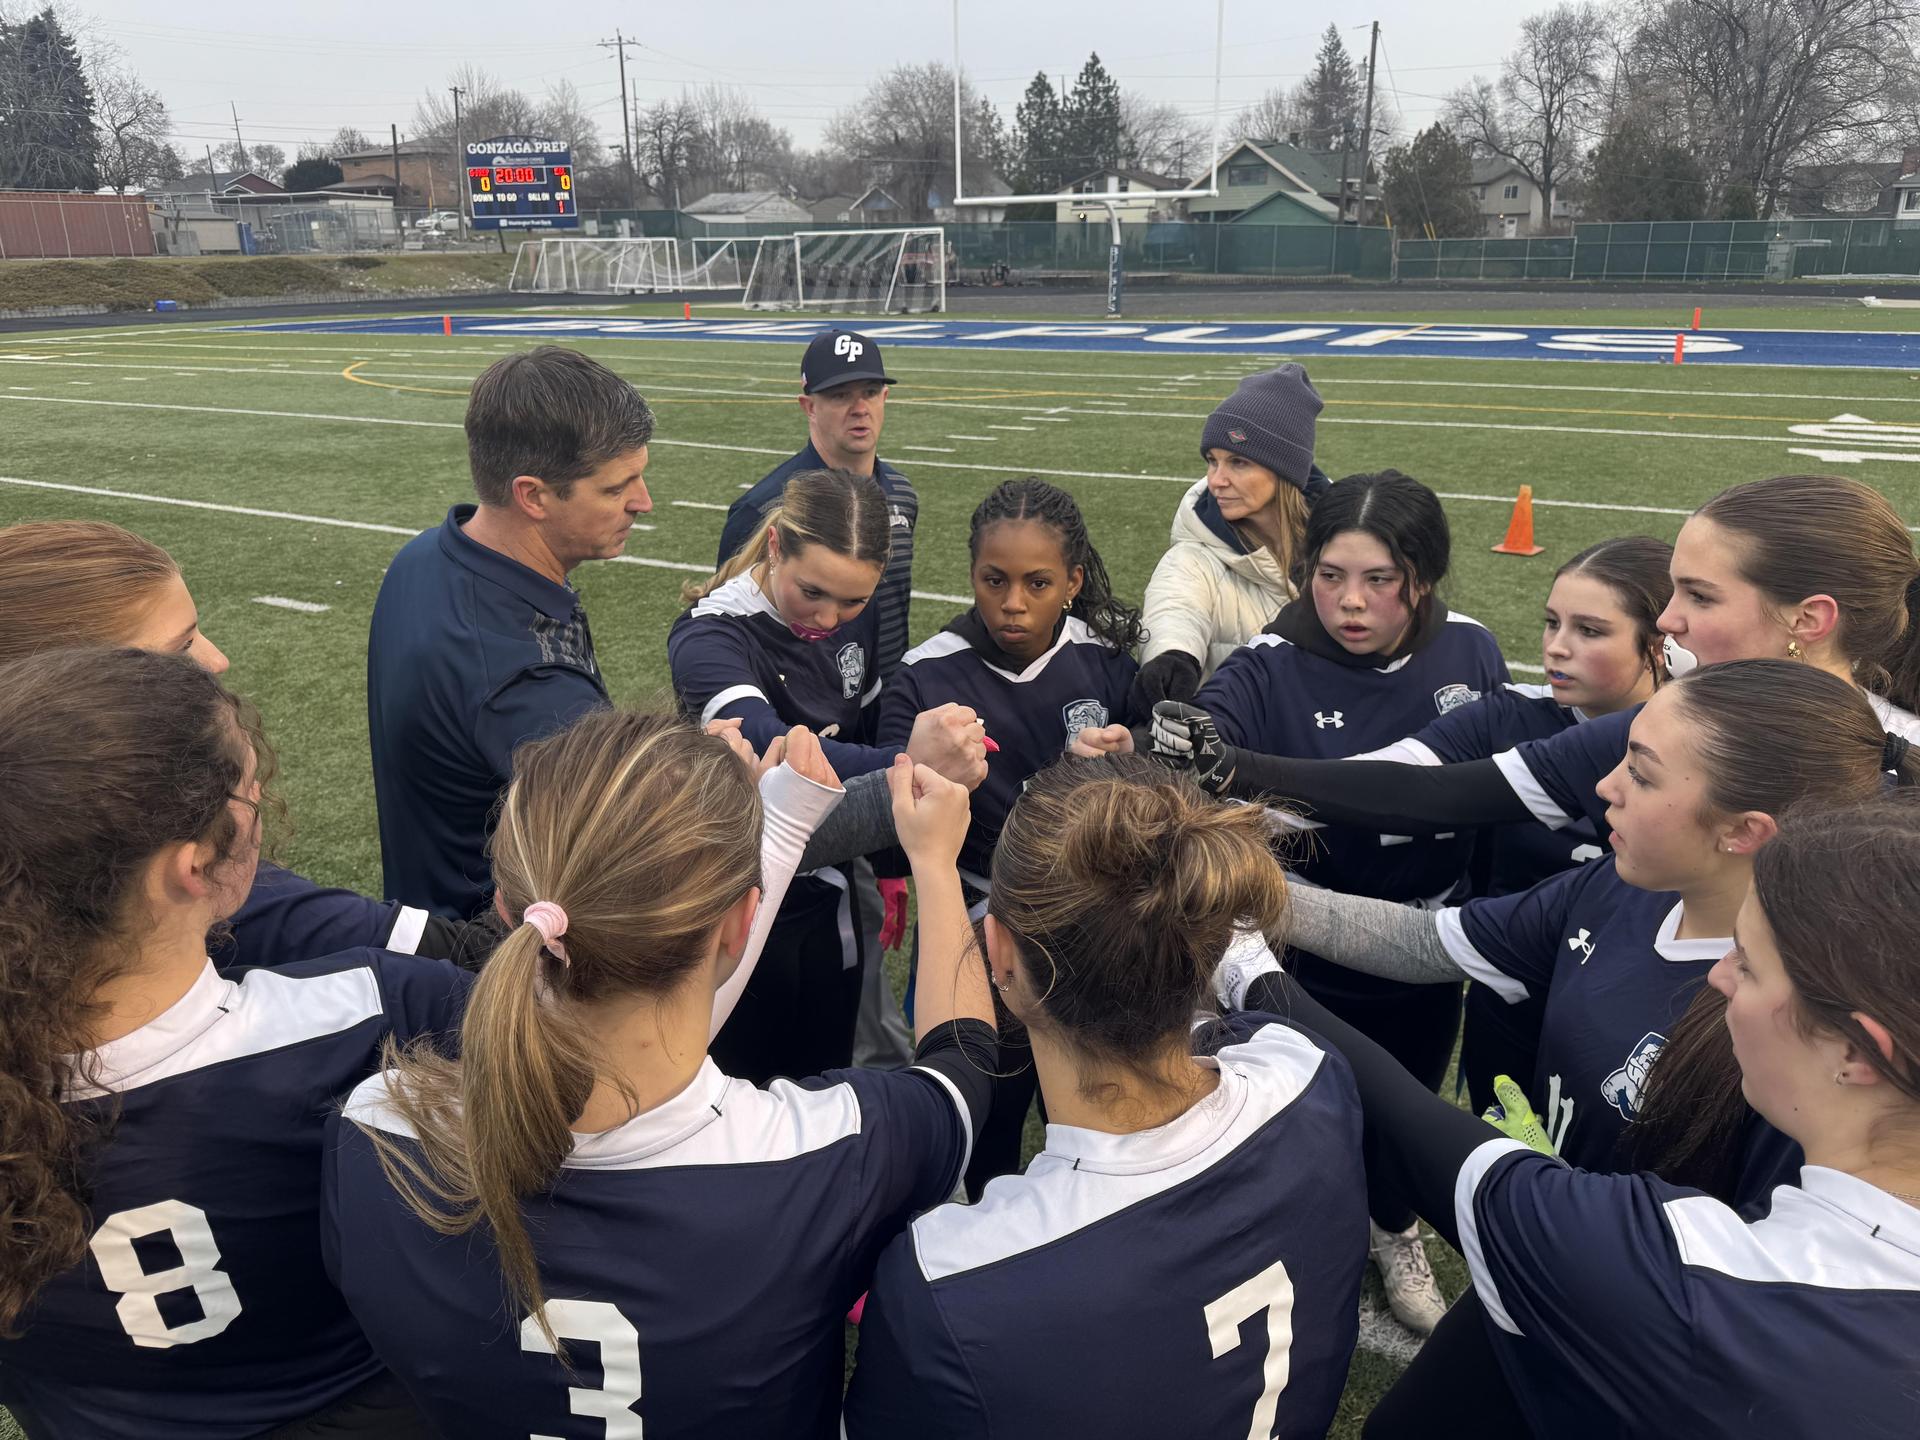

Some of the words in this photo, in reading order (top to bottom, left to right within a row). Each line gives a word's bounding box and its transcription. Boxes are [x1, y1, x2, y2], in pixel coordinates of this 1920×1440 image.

[467, 143, 531, 154] GONZAGA
[534, 141, 568, 153] PREP
[495, 167, 534, 183] 20:00
[561, 175, 570, 190] 0
[481, 176, 490, 191] 0
[473, 193, 493, 202] DOWN
[834, 335, 863, 362] GP
[89, 1199, 242, 1348] 8
[1203, 1260, 1294, 1440] 7
[520, 1299, 643, 1440] 3
